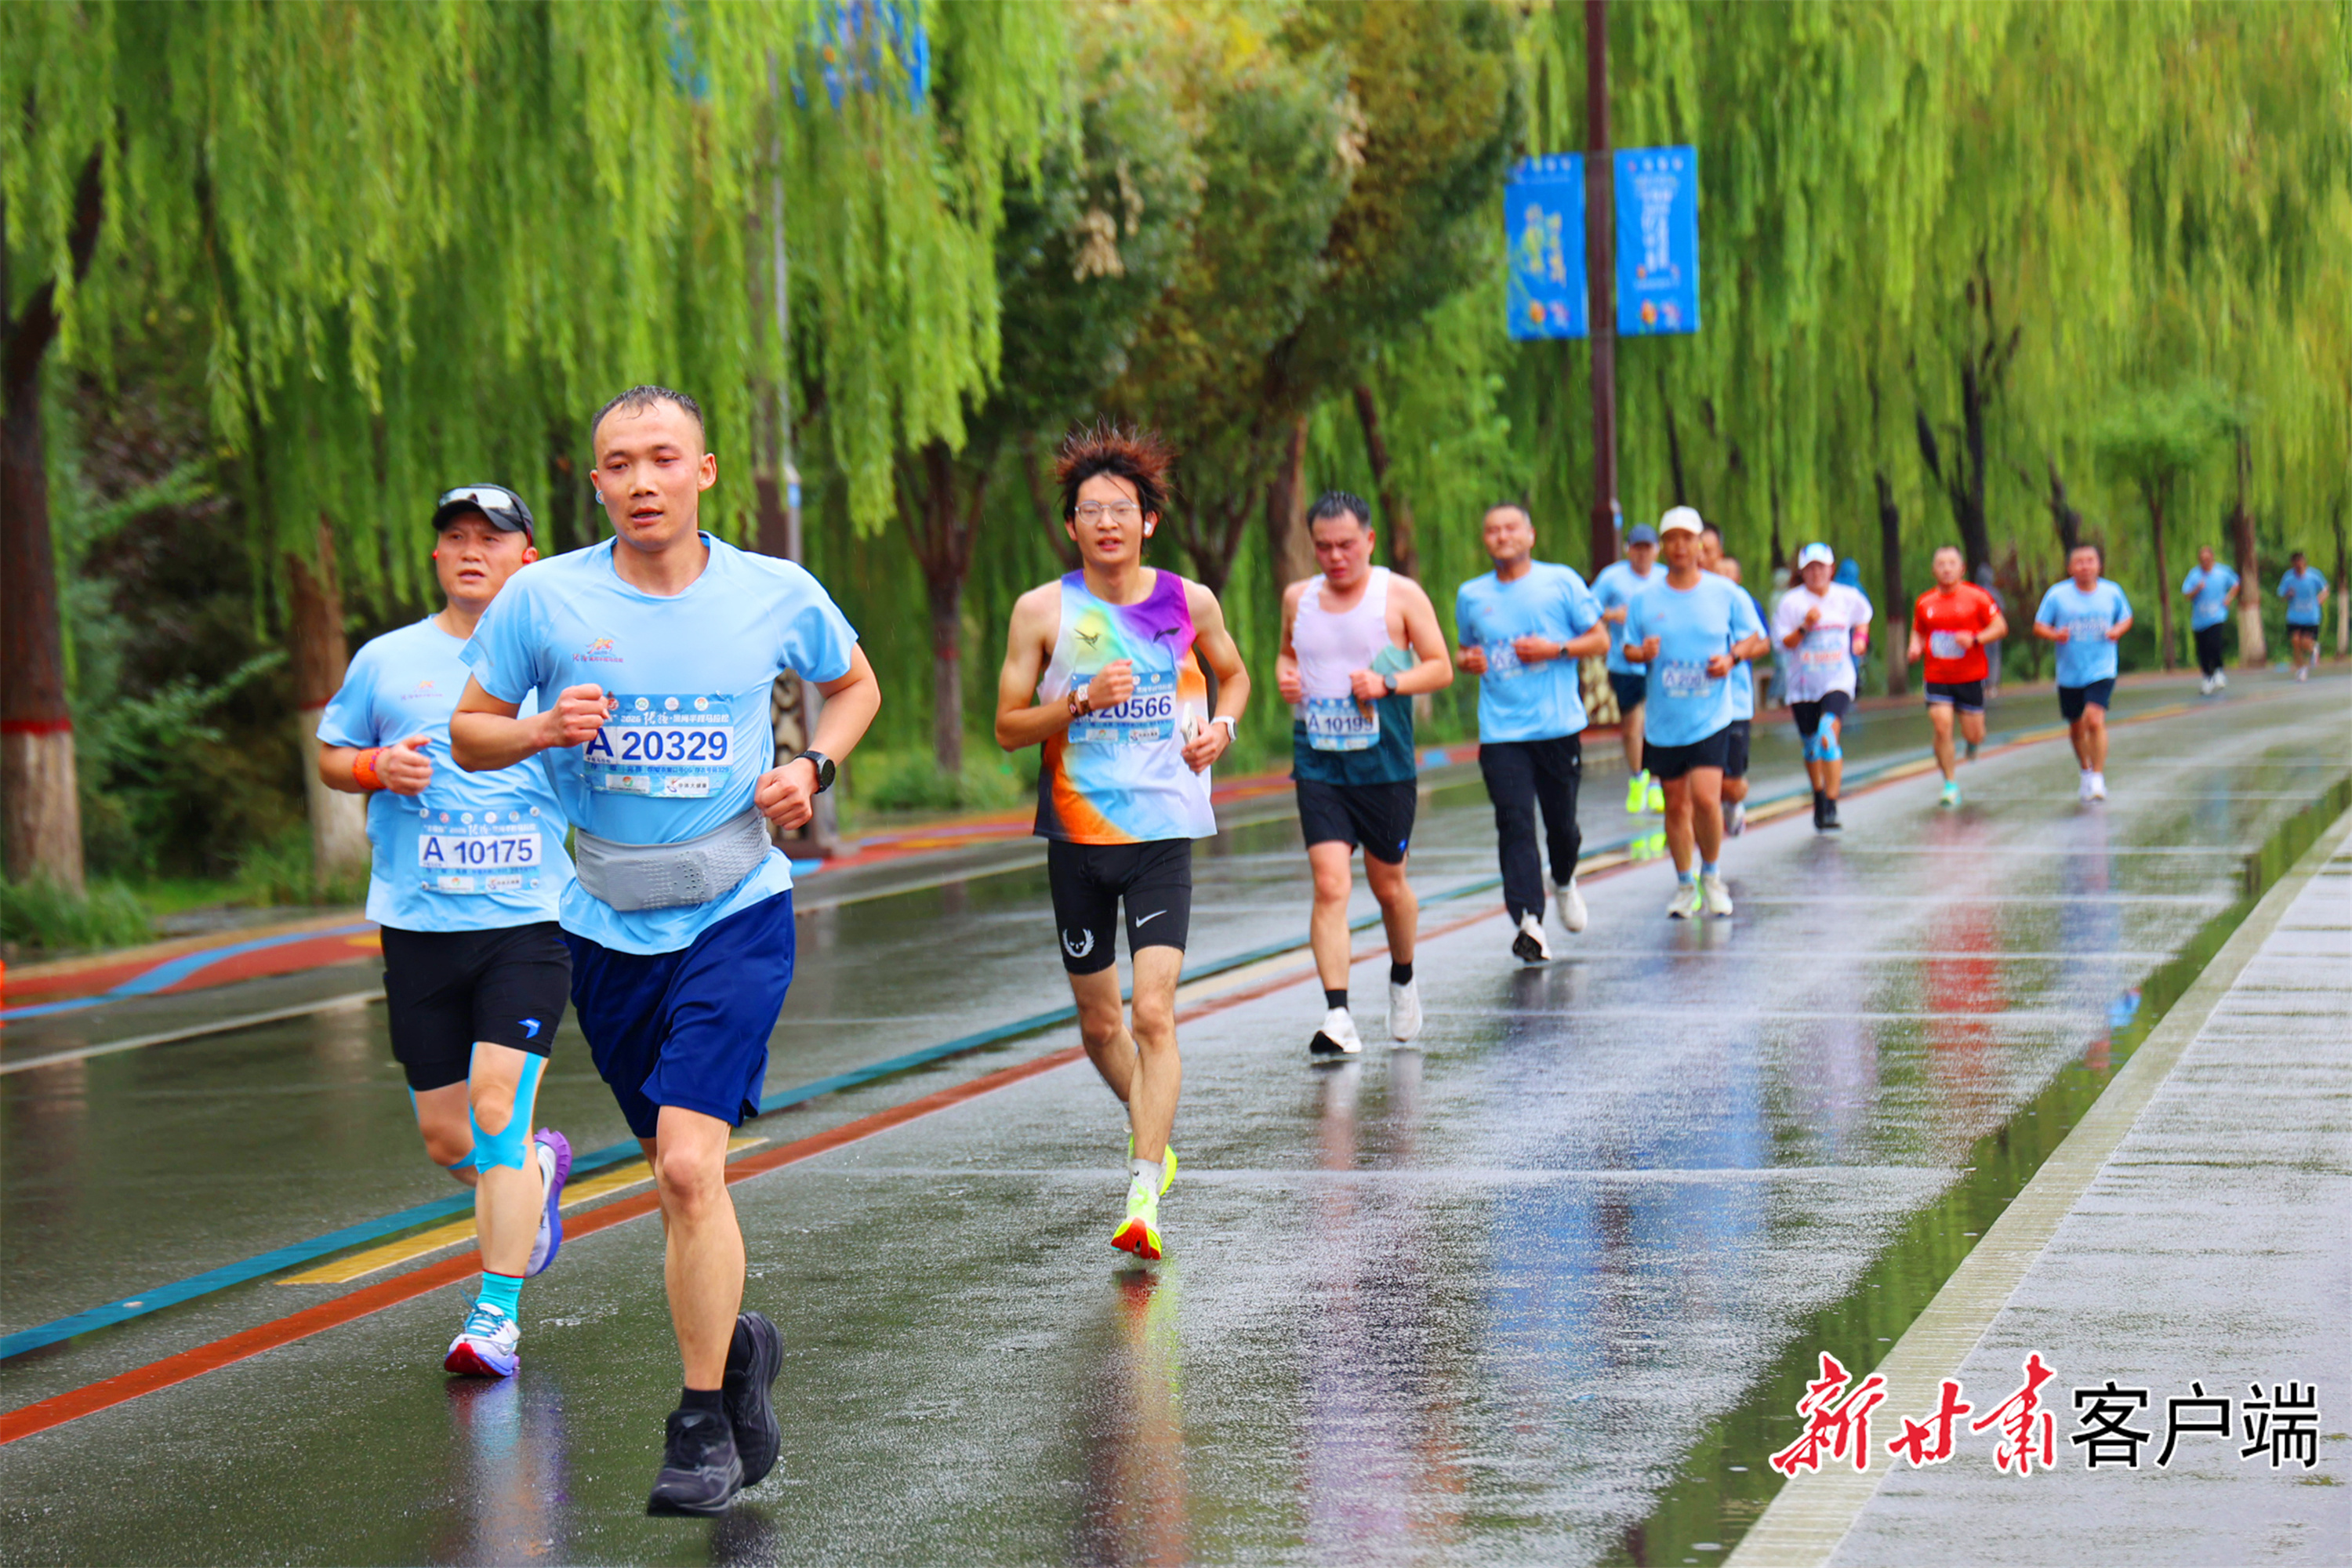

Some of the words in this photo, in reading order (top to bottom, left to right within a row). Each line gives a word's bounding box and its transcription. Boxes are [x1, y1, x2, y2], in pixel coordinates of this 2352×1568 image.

[1308, 713, 1319, 731] A
[585, 728, 614, 757] A
[622, 731, 728, 760] 20329
[423, 837, 444, 862] A
[454, 839, 533, 864] 10175
